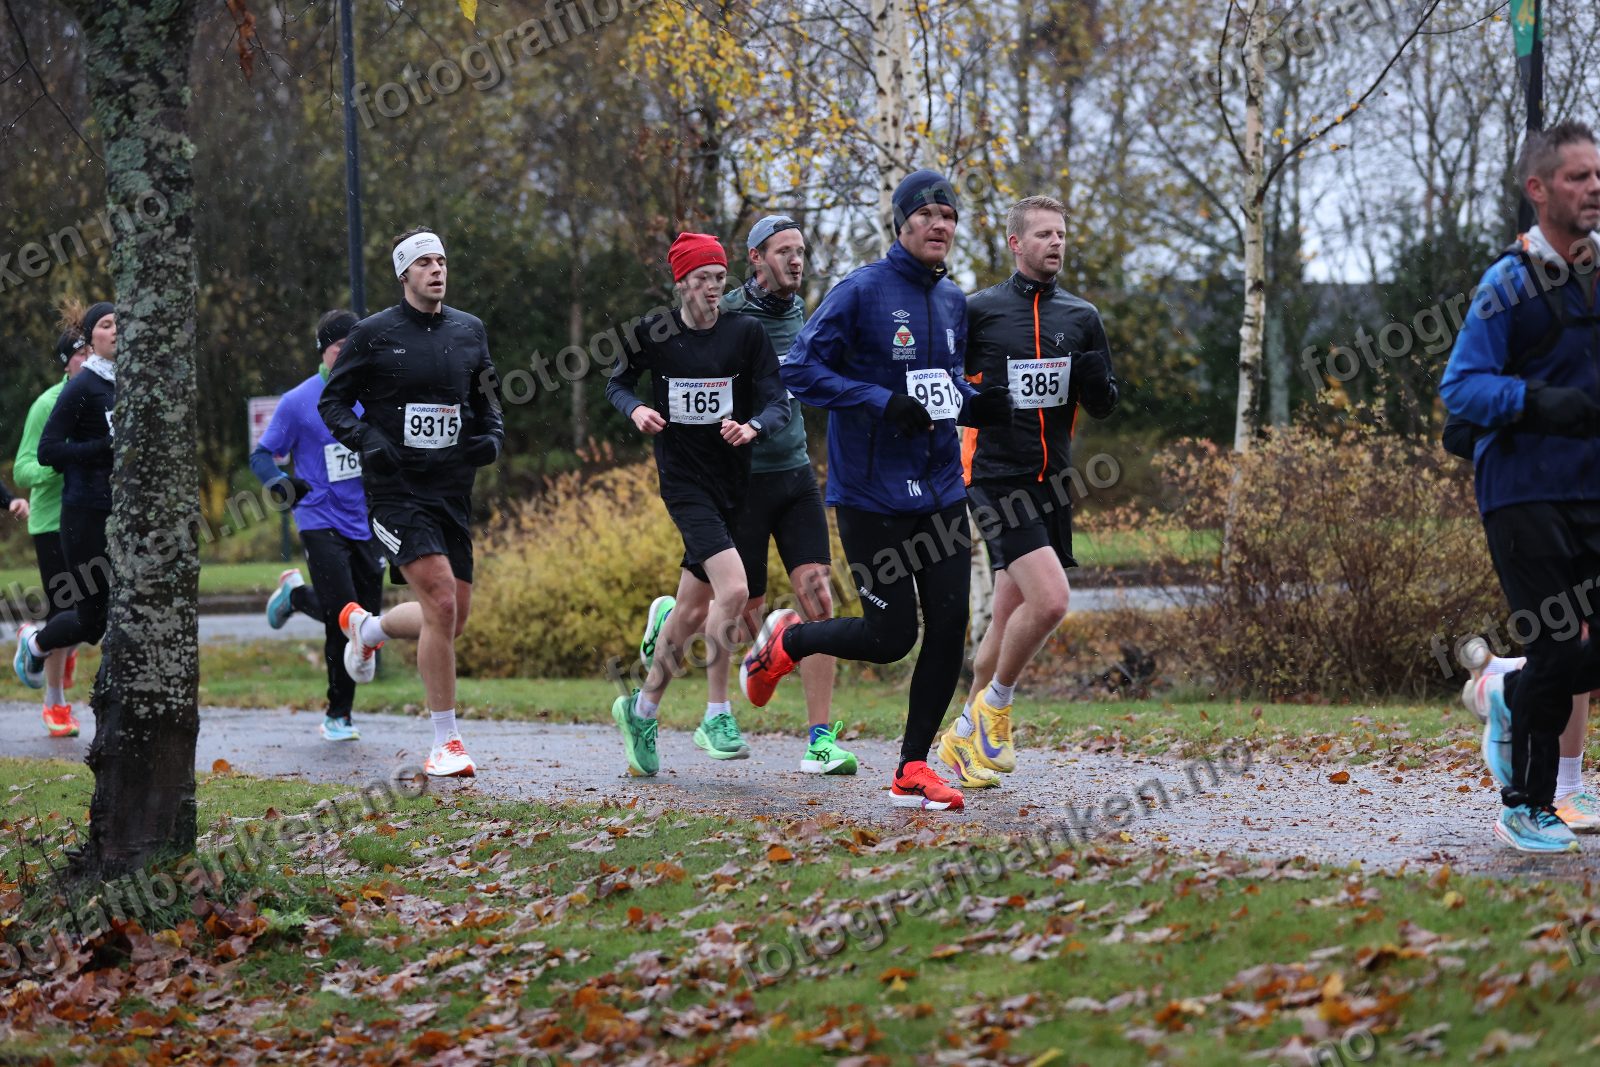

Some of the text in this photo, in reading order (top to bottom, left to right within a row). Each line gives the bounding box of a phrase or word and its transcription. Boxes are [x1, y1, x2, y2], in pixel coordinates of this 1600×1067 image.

[1013, 361, 1067, 370] NORGESTESTEN
[1021, 372, 1060, 397] 385
[682, 391, 720, 414] 165
[410, 415, 459, 437] 9315
[336, 452, 361, 471] 76
[907, 479, 922, 497] TN
